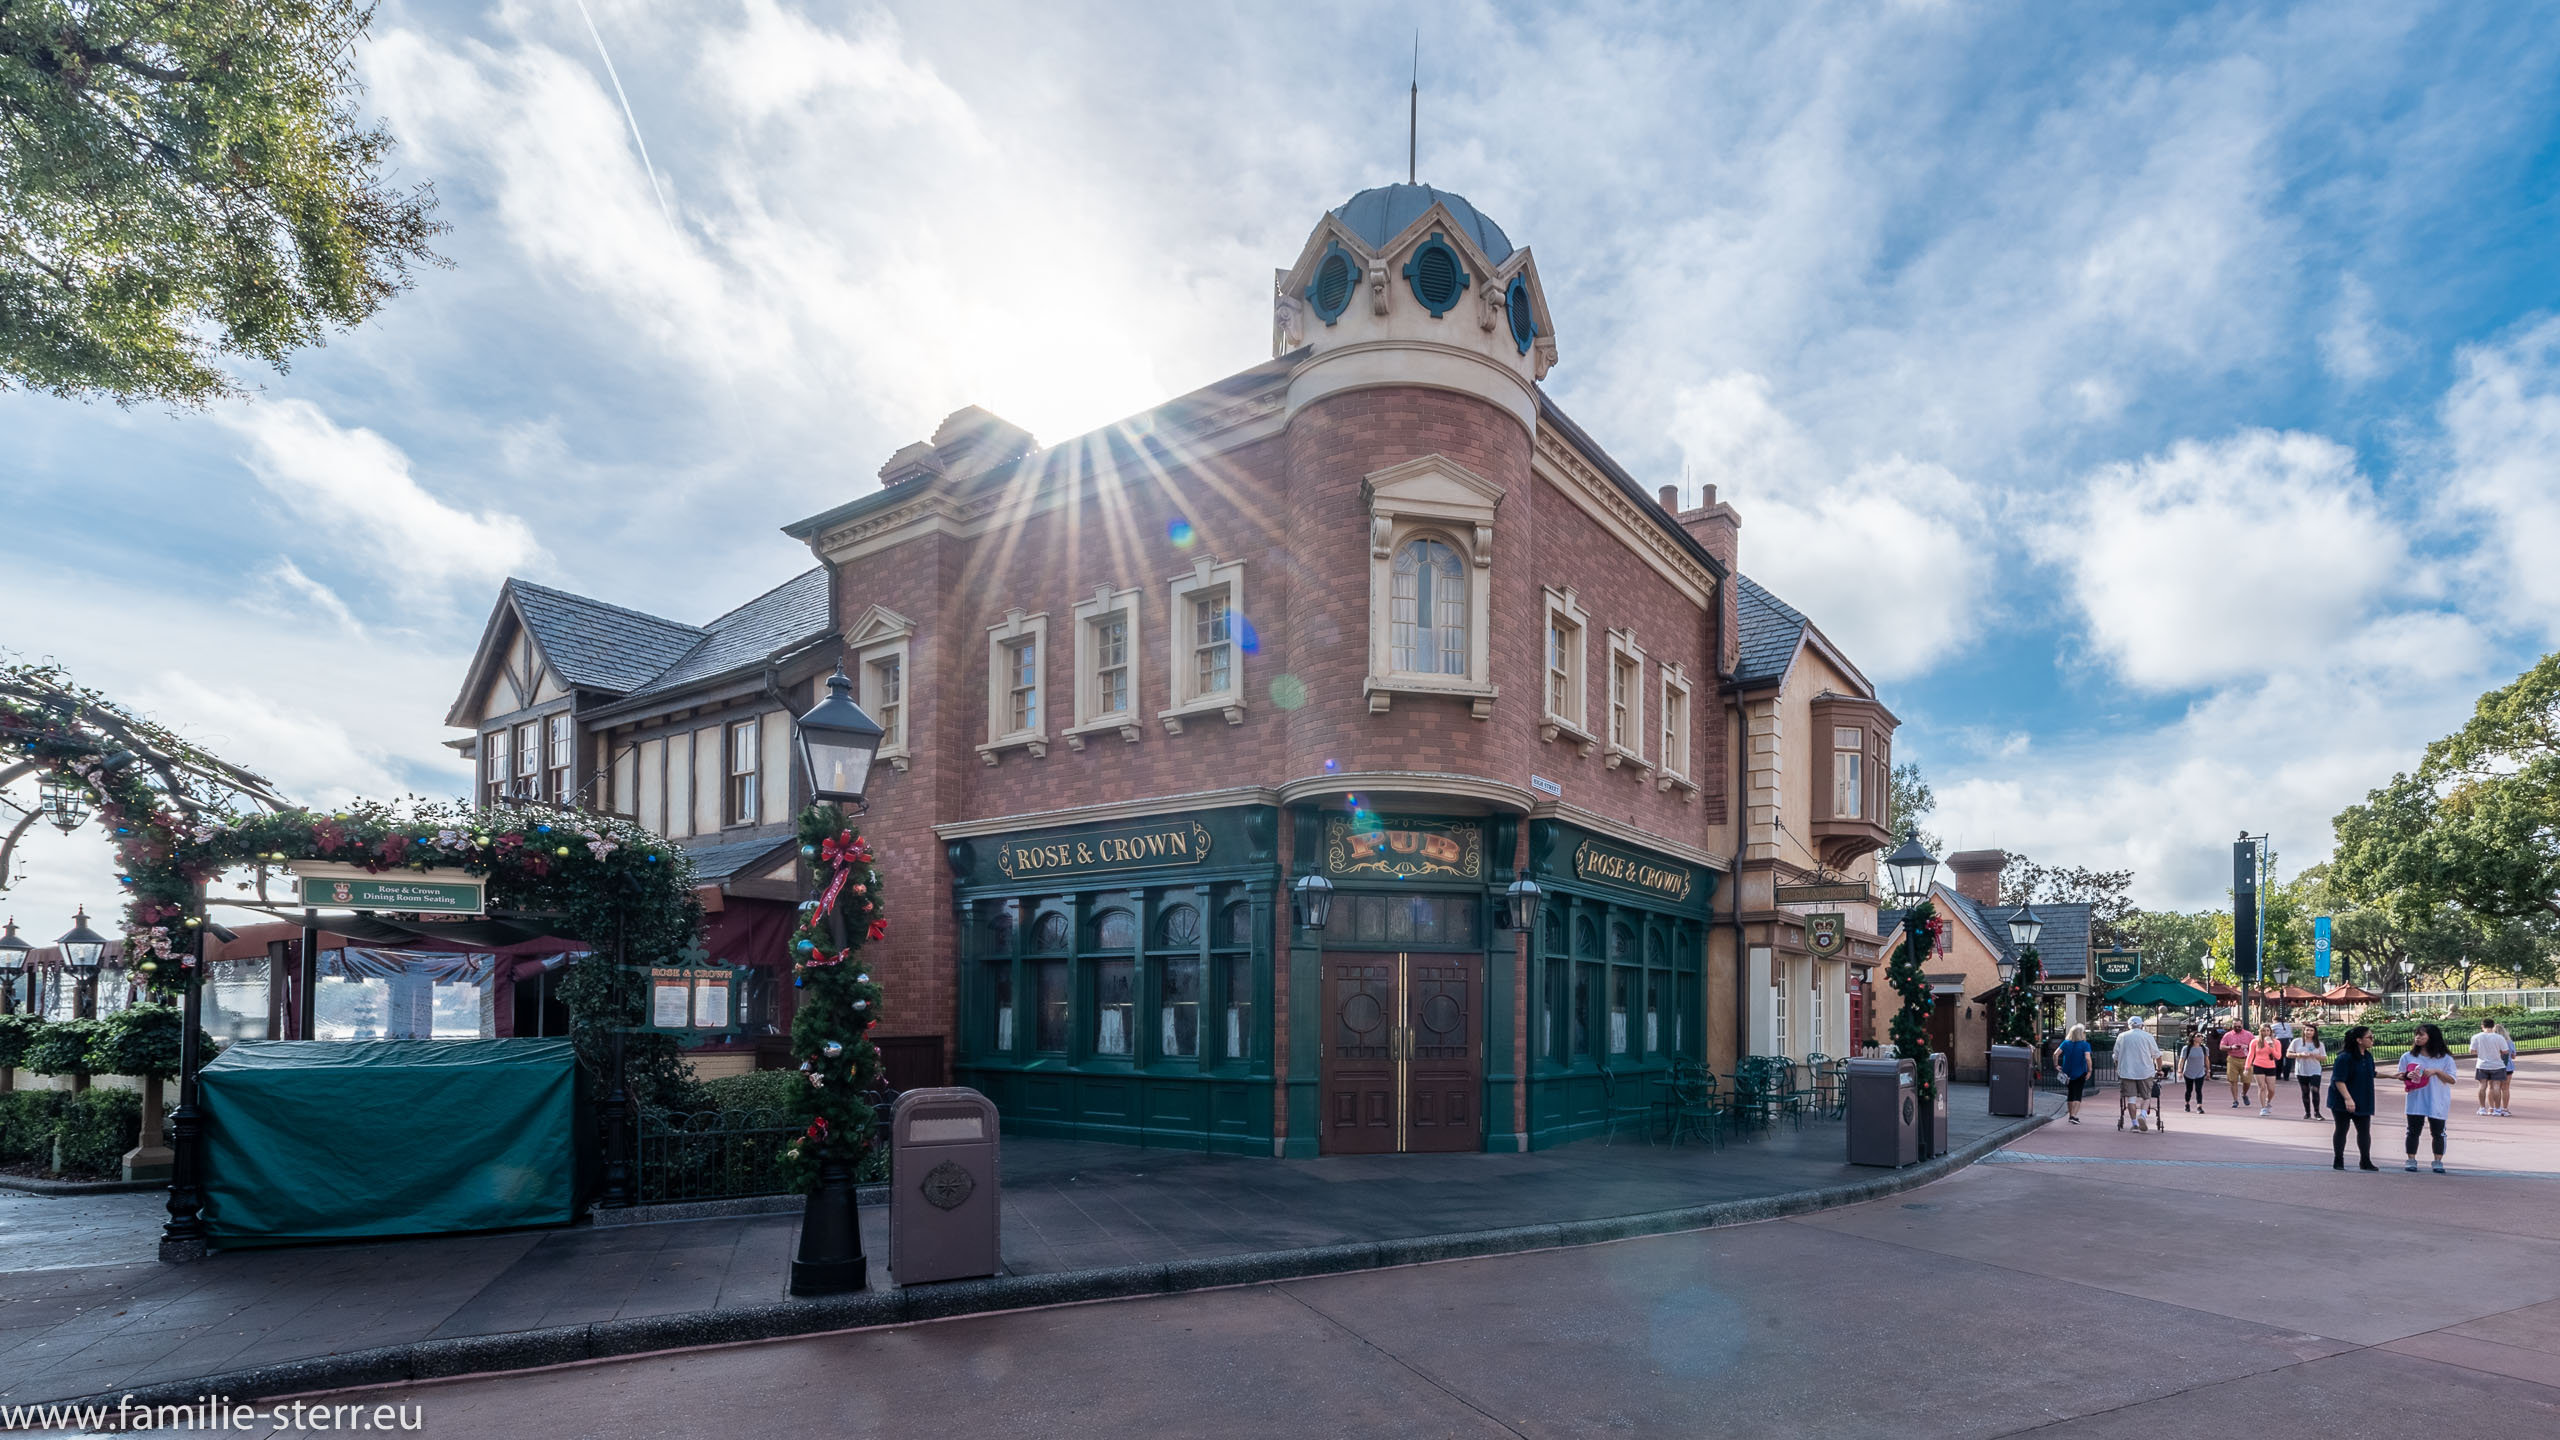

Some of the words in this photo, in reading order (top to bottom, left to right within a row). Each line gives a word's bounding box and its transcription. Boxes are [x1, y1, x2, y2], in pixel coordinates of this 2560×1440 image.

[1016, 843, 1073, 870] ROSE
[1077, 842, 1095, 865] &
[1099, 831, 1188, 862] CROWN
[1346, 830, 1460, 863] PUB
[1587, 850, 1625, 879] ROSE
[1625, 862, 1636, 883] &
[1639, 865, 1683, 894] CROWN
[363, 892, 395, 902] Dining
[396, 894, 422, 902] Room
[423, 895, 456, 905] Seating
[378, 885, 400, 894] Rose
[411, 887, 441, 895] Crown
[651, 967, 680, 977] ROSE
[682, 968, 692, 978] &
[693, 969, 733, 979] CROWN
